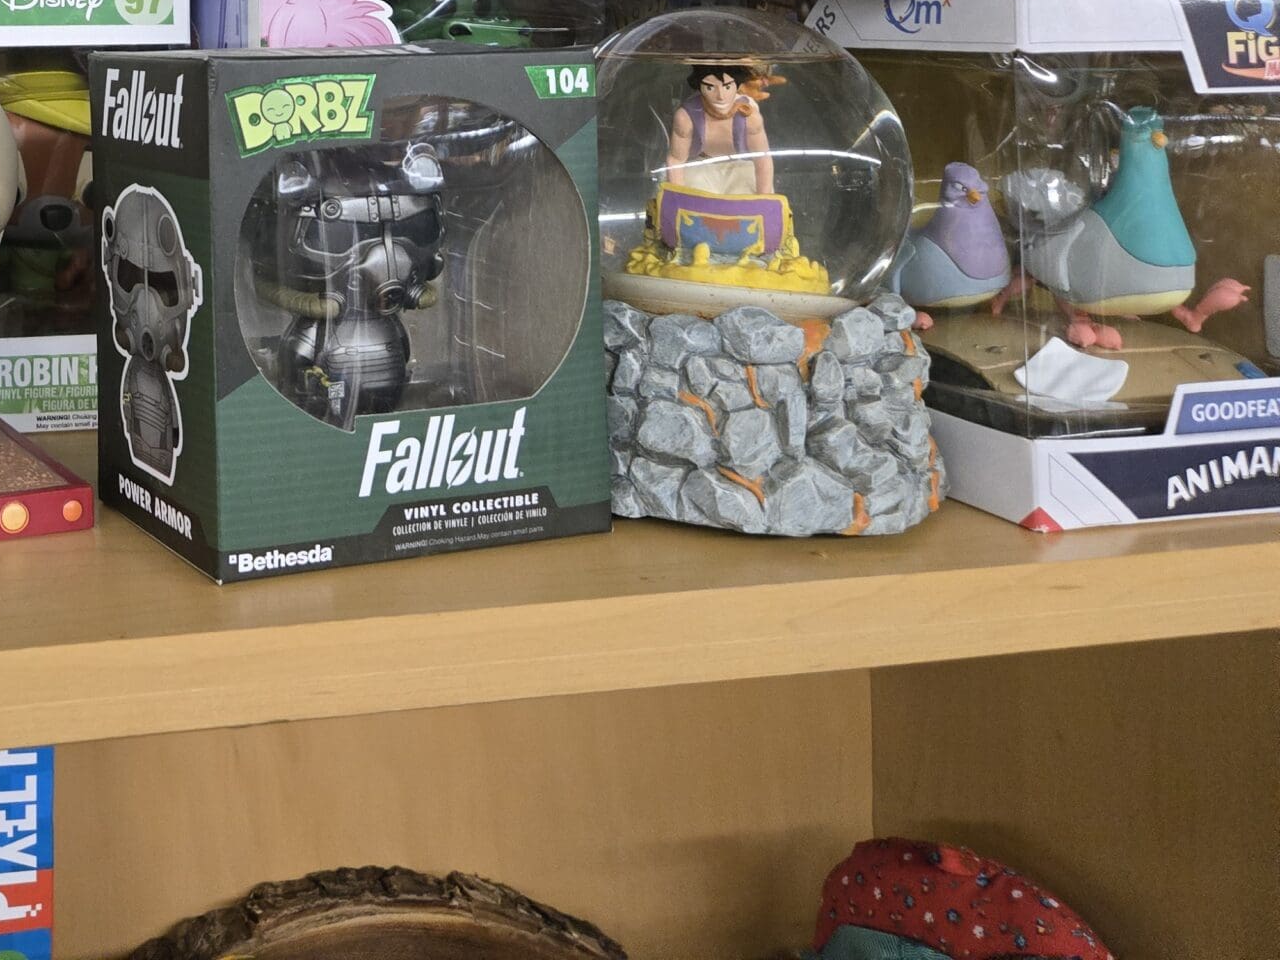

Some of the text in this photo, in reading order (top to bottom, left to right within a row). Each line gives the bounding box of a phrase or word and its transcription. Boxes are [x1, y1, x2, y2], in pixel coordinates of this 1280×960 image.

[544, 66, 590, 95] 104
[101, 68, 184, 150] Fallout
[24, 387, 57, 399] FIGURE
[42, 399, 76, 411] FIGURA
[78, 399, 90, 410] DE
[358, 406, 526, 498] Fallout
[118, 473, 193, 541] POWER ARMOR
[391, 506, 548, 538] COLLECTION DE VINYLE COLECCIÓN DE VINILO
[403, 492, 540, 522] VINYL COLLECTIBLE
[237, 544, 334, 574] Bethesda
